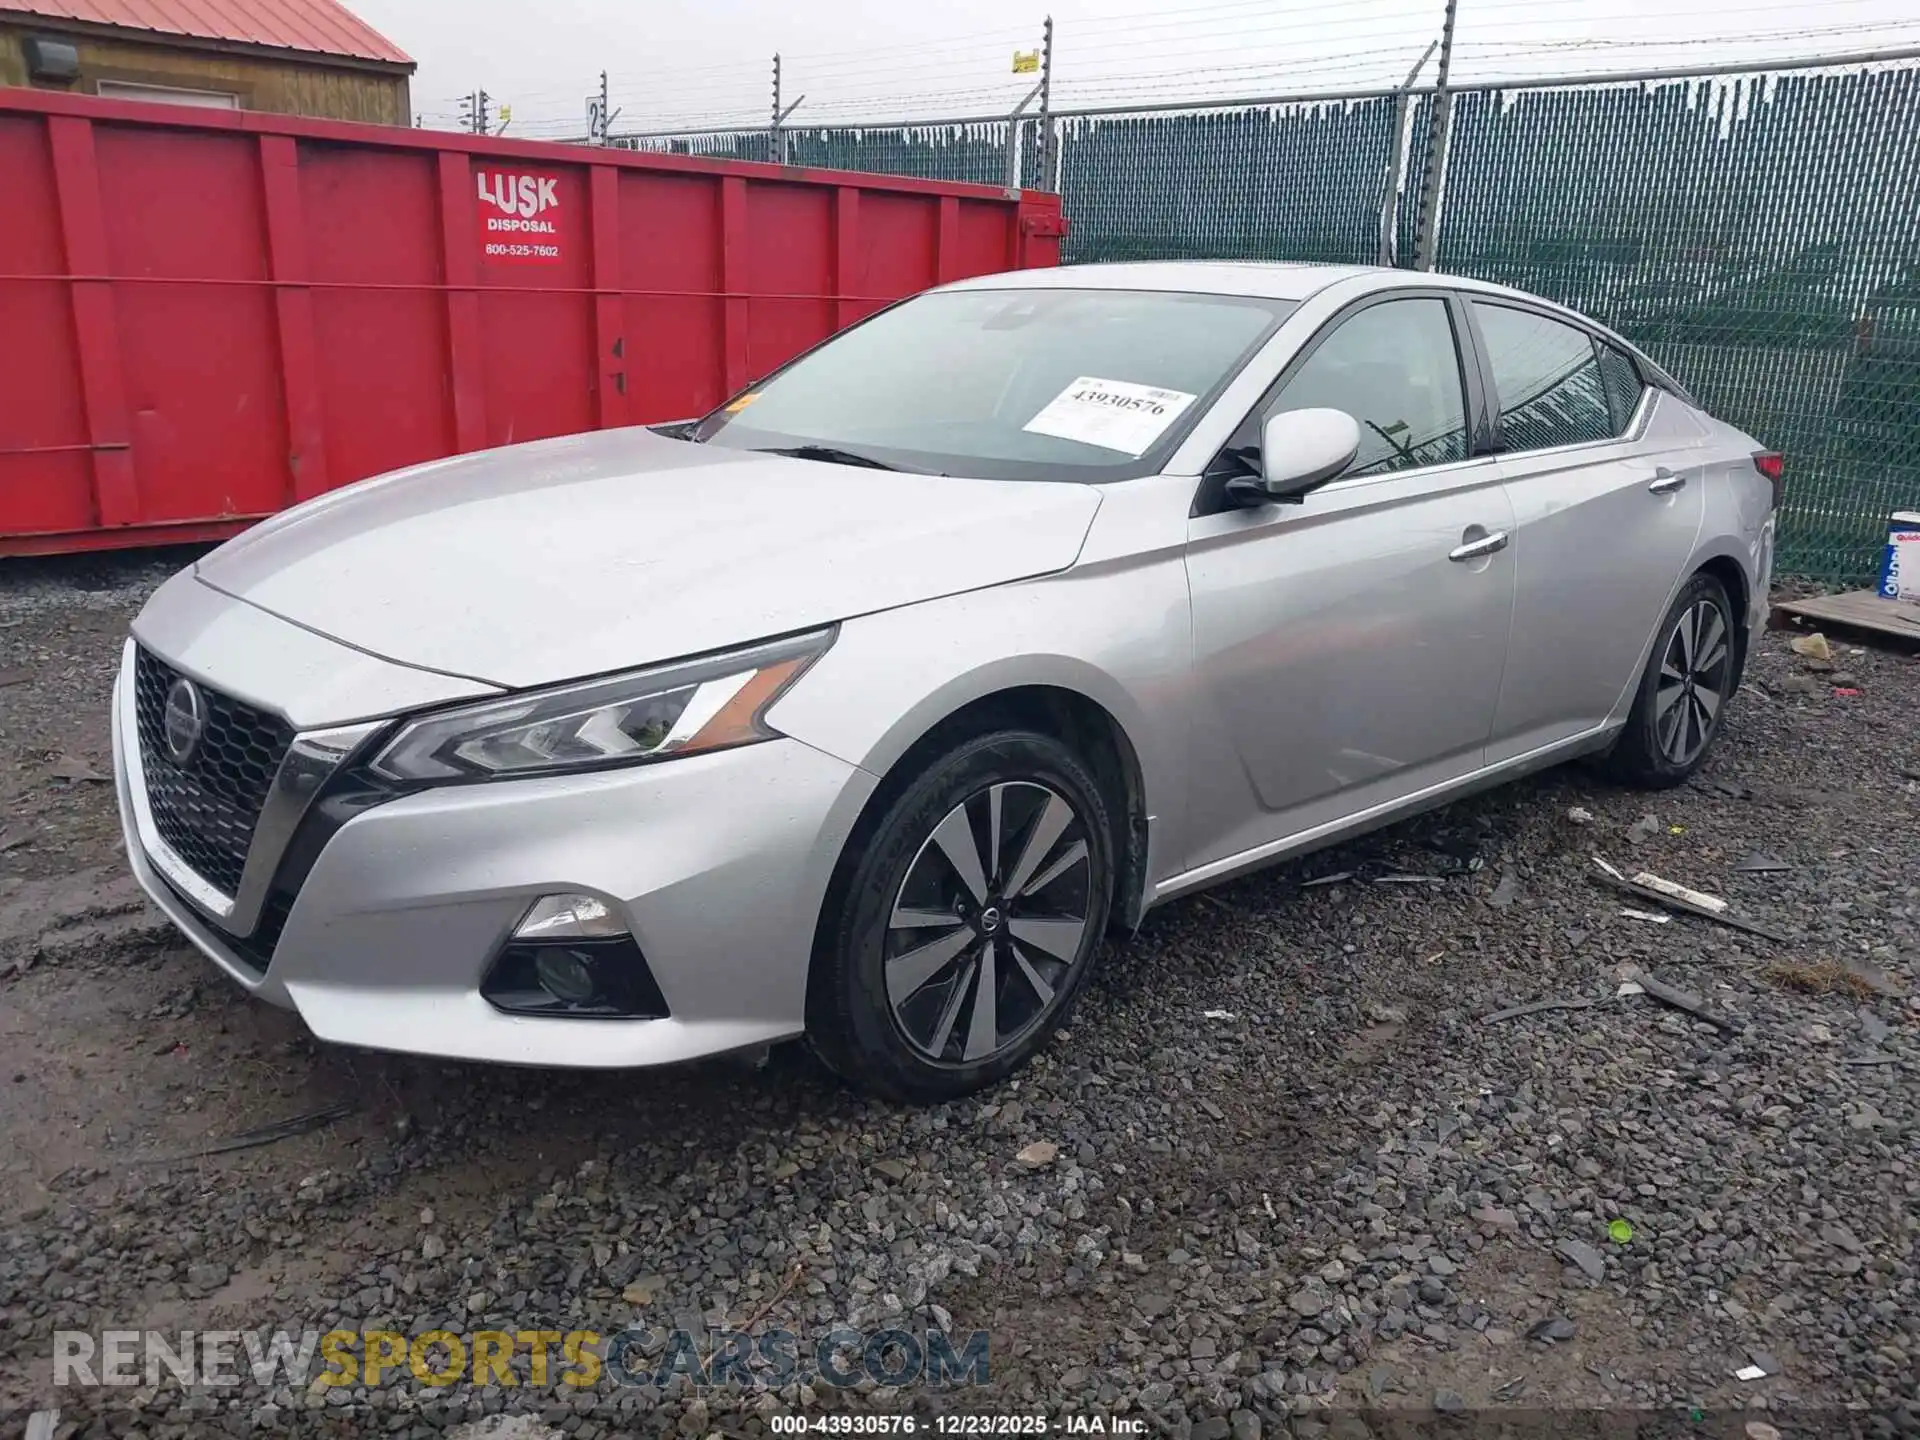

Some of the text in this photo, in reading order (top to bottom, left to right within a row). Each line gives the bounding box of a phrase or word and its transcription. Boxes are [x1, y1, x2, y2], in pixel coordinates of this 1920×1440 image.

[477, 171, 559, 218] LUSK
[487, 218, 556, 233] DISPOSAL
[1071, 389, 1165, 416] 43930576
